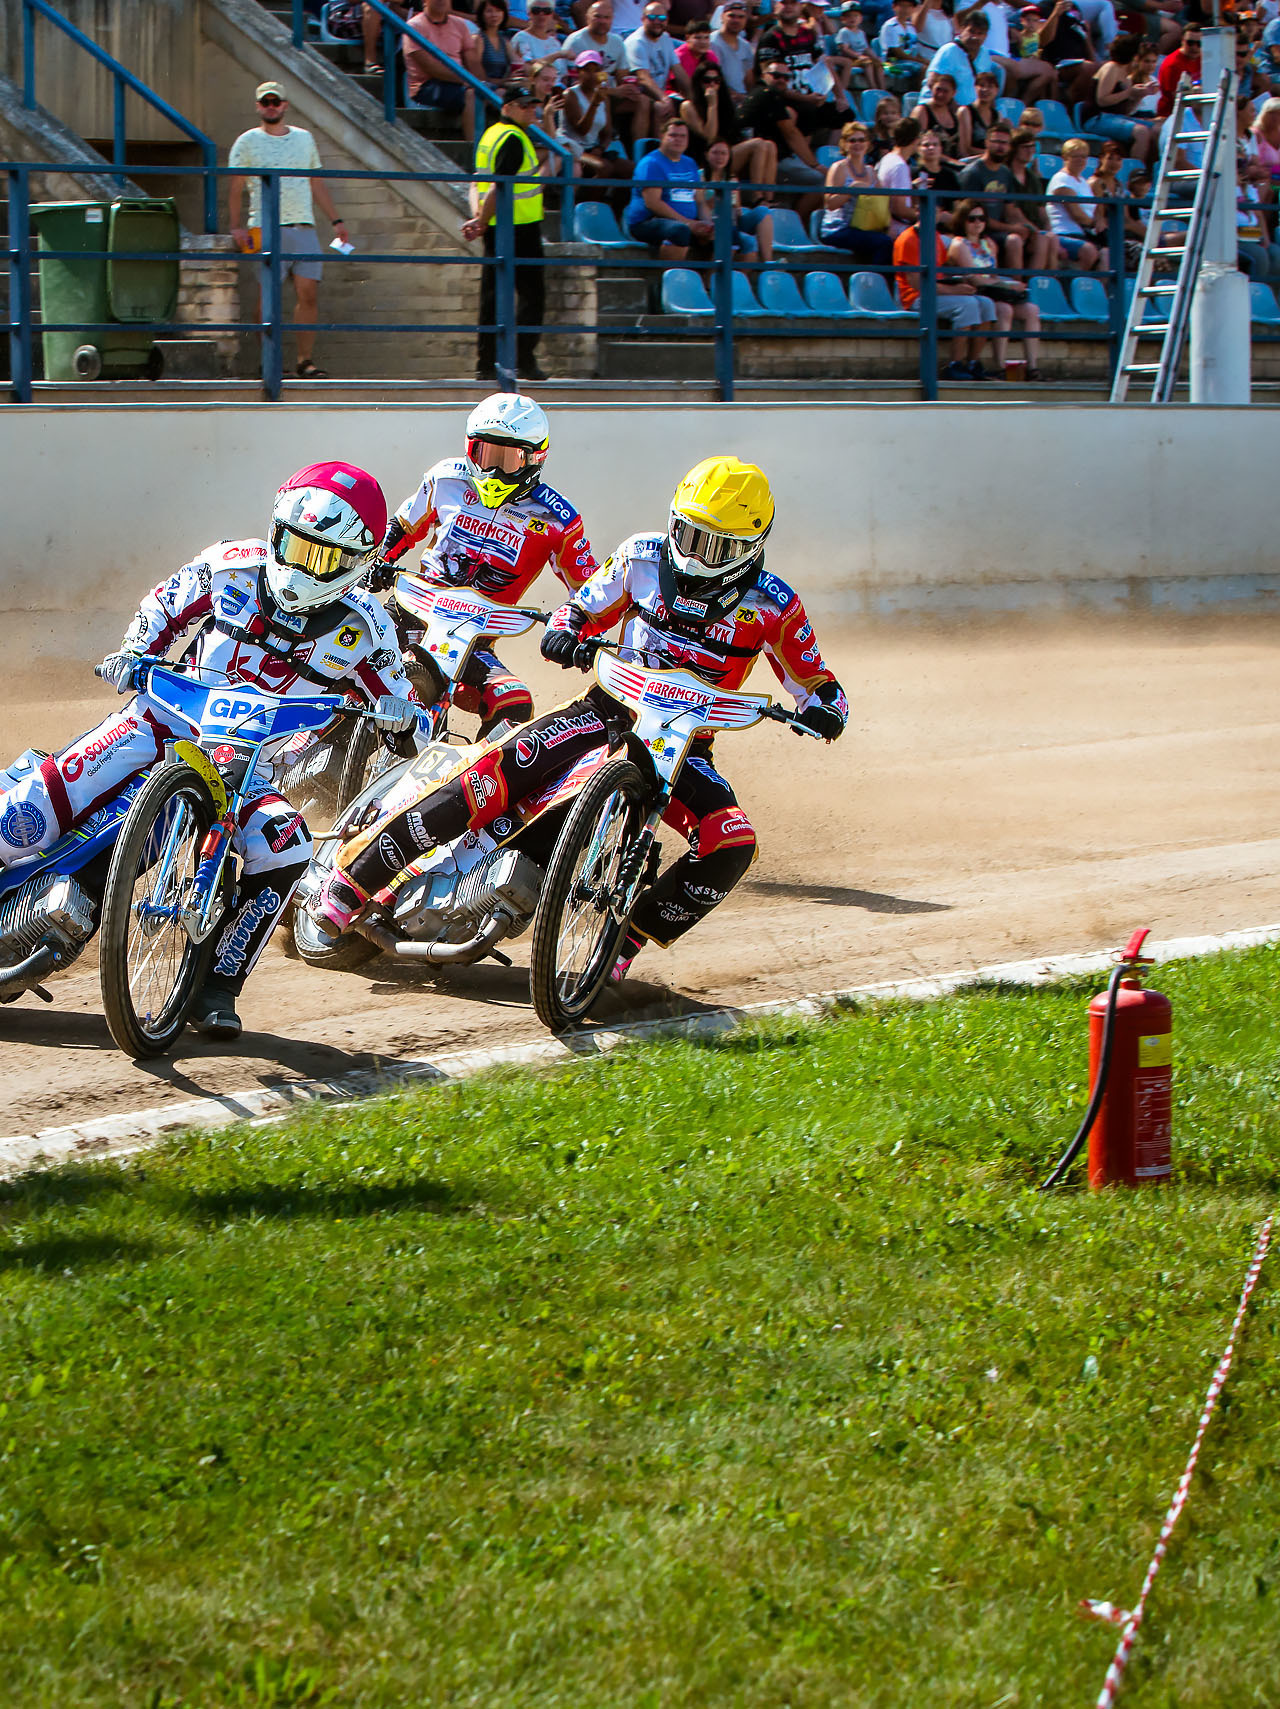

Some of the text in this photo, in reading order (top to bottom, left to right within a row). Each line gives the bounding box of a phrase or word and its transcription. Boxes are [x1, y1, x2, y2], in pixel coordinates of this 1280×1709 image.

[537, 488, 572, 520] Nice
[455, 514, 523, 551] ABRAMCZYK
[276, 610, 303, 630] GPA
[646, 681, 711, 707] ABRAMCZYK
[210, 698, 267, 726] GPA
[468, 770, 487, 809] PRES
[410, 811, 437, 849] mario
[660, 909, 690, 922] CASINO
